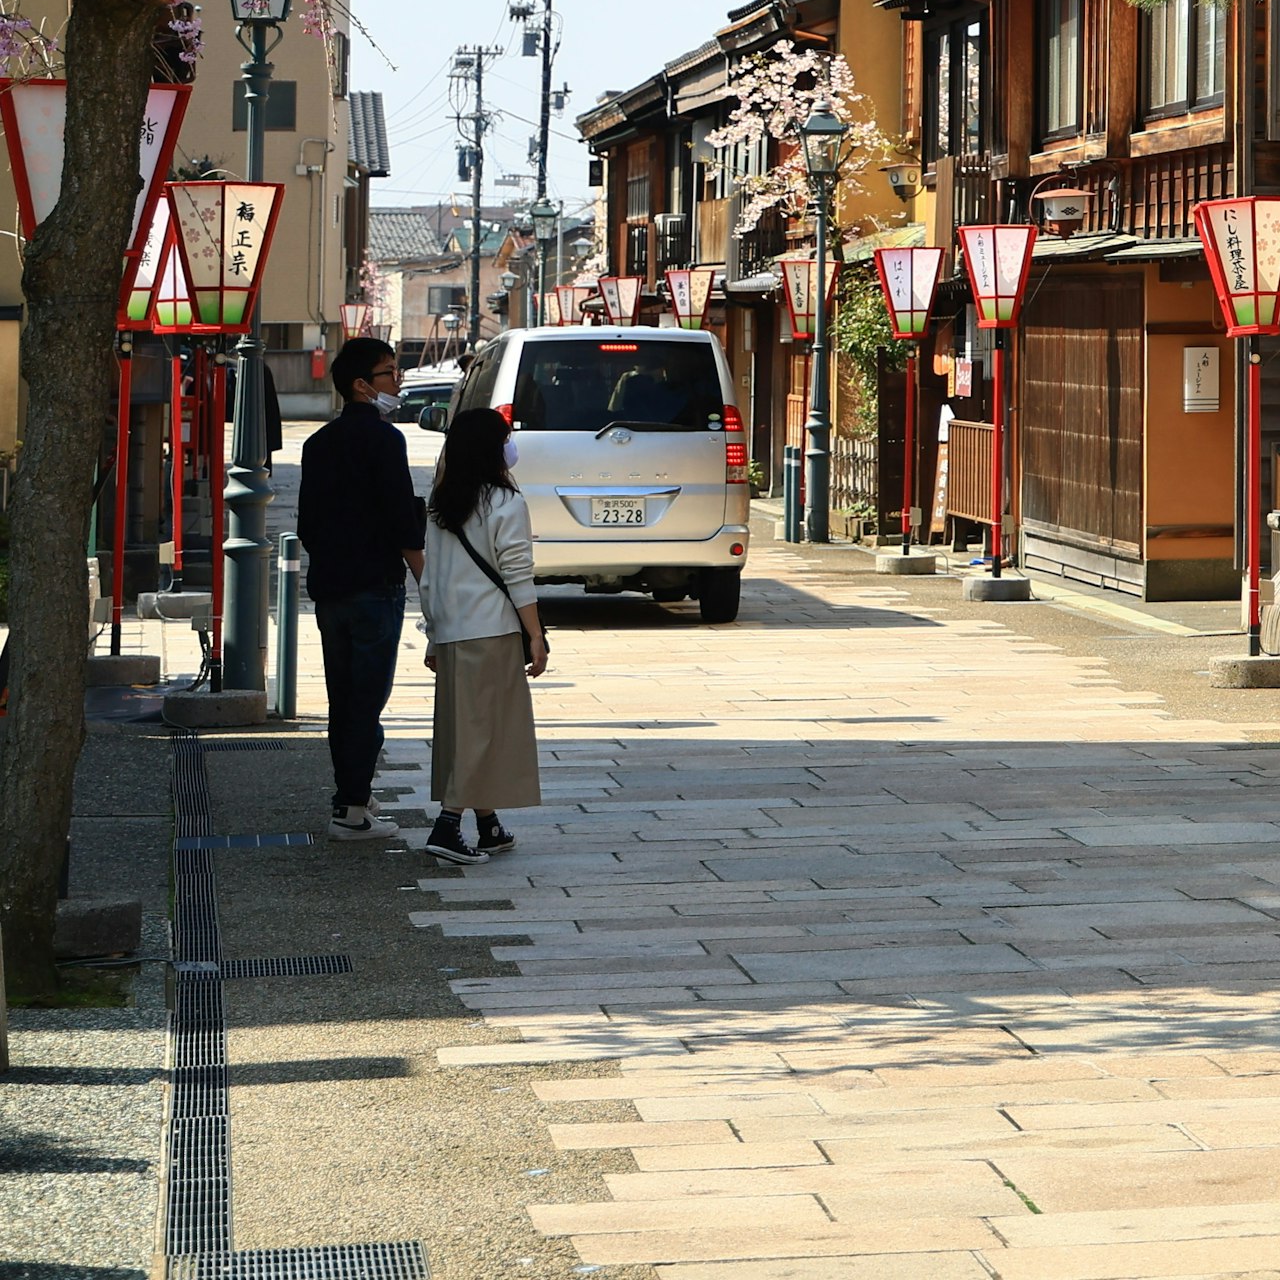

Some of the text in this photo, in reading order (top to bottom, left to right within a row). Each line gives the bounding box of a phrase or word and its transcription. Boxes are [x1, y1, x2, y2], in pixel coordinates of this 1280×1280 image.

[227, 201, 256, 275] 福正宗
[977, 232, 990, 288] 人形ミュージアム
[602, 509, 643, 523] 23-28
